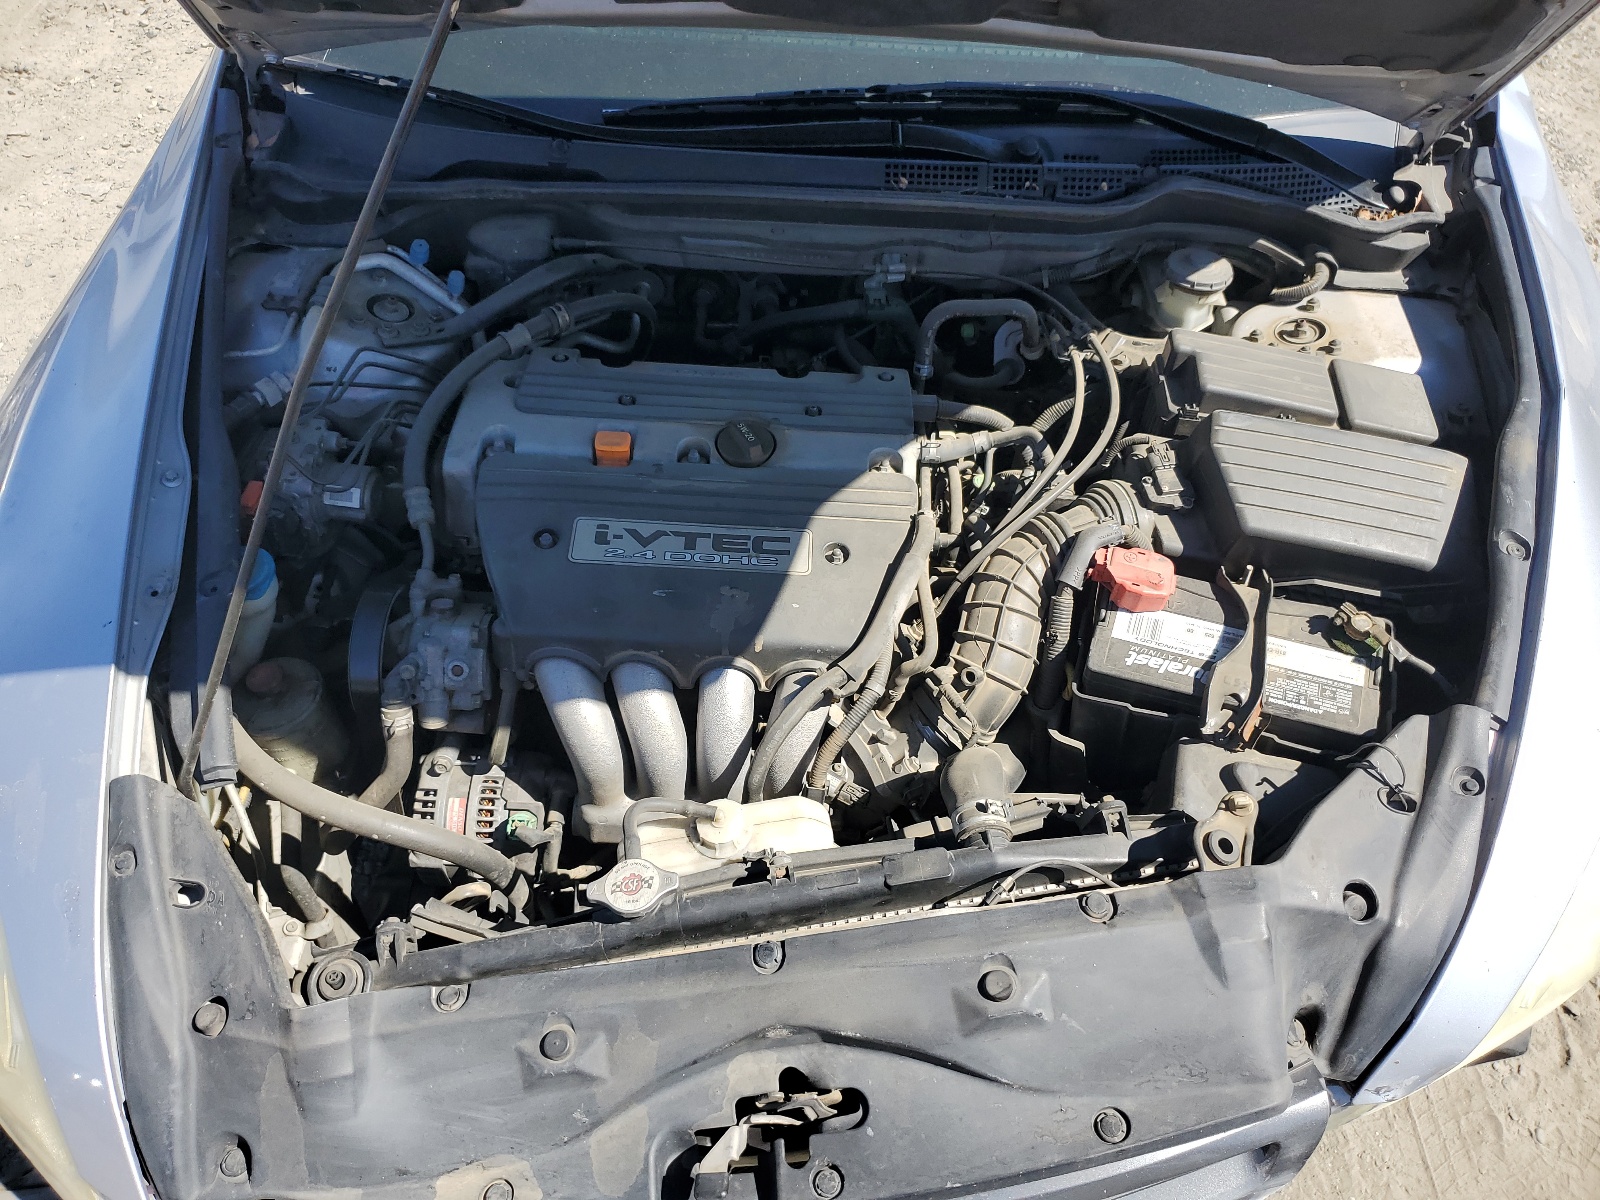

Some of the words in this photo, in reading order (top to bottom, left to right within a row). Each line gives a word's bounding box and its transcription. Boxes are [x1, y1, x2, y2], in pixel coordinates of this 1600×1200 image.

[594, 524, 790, 555] i-VTEC
[603, 548, 656, 560] 2.4
[663, 550, 779, 567] DOHC
[622, 878, 639, 892] CSF
